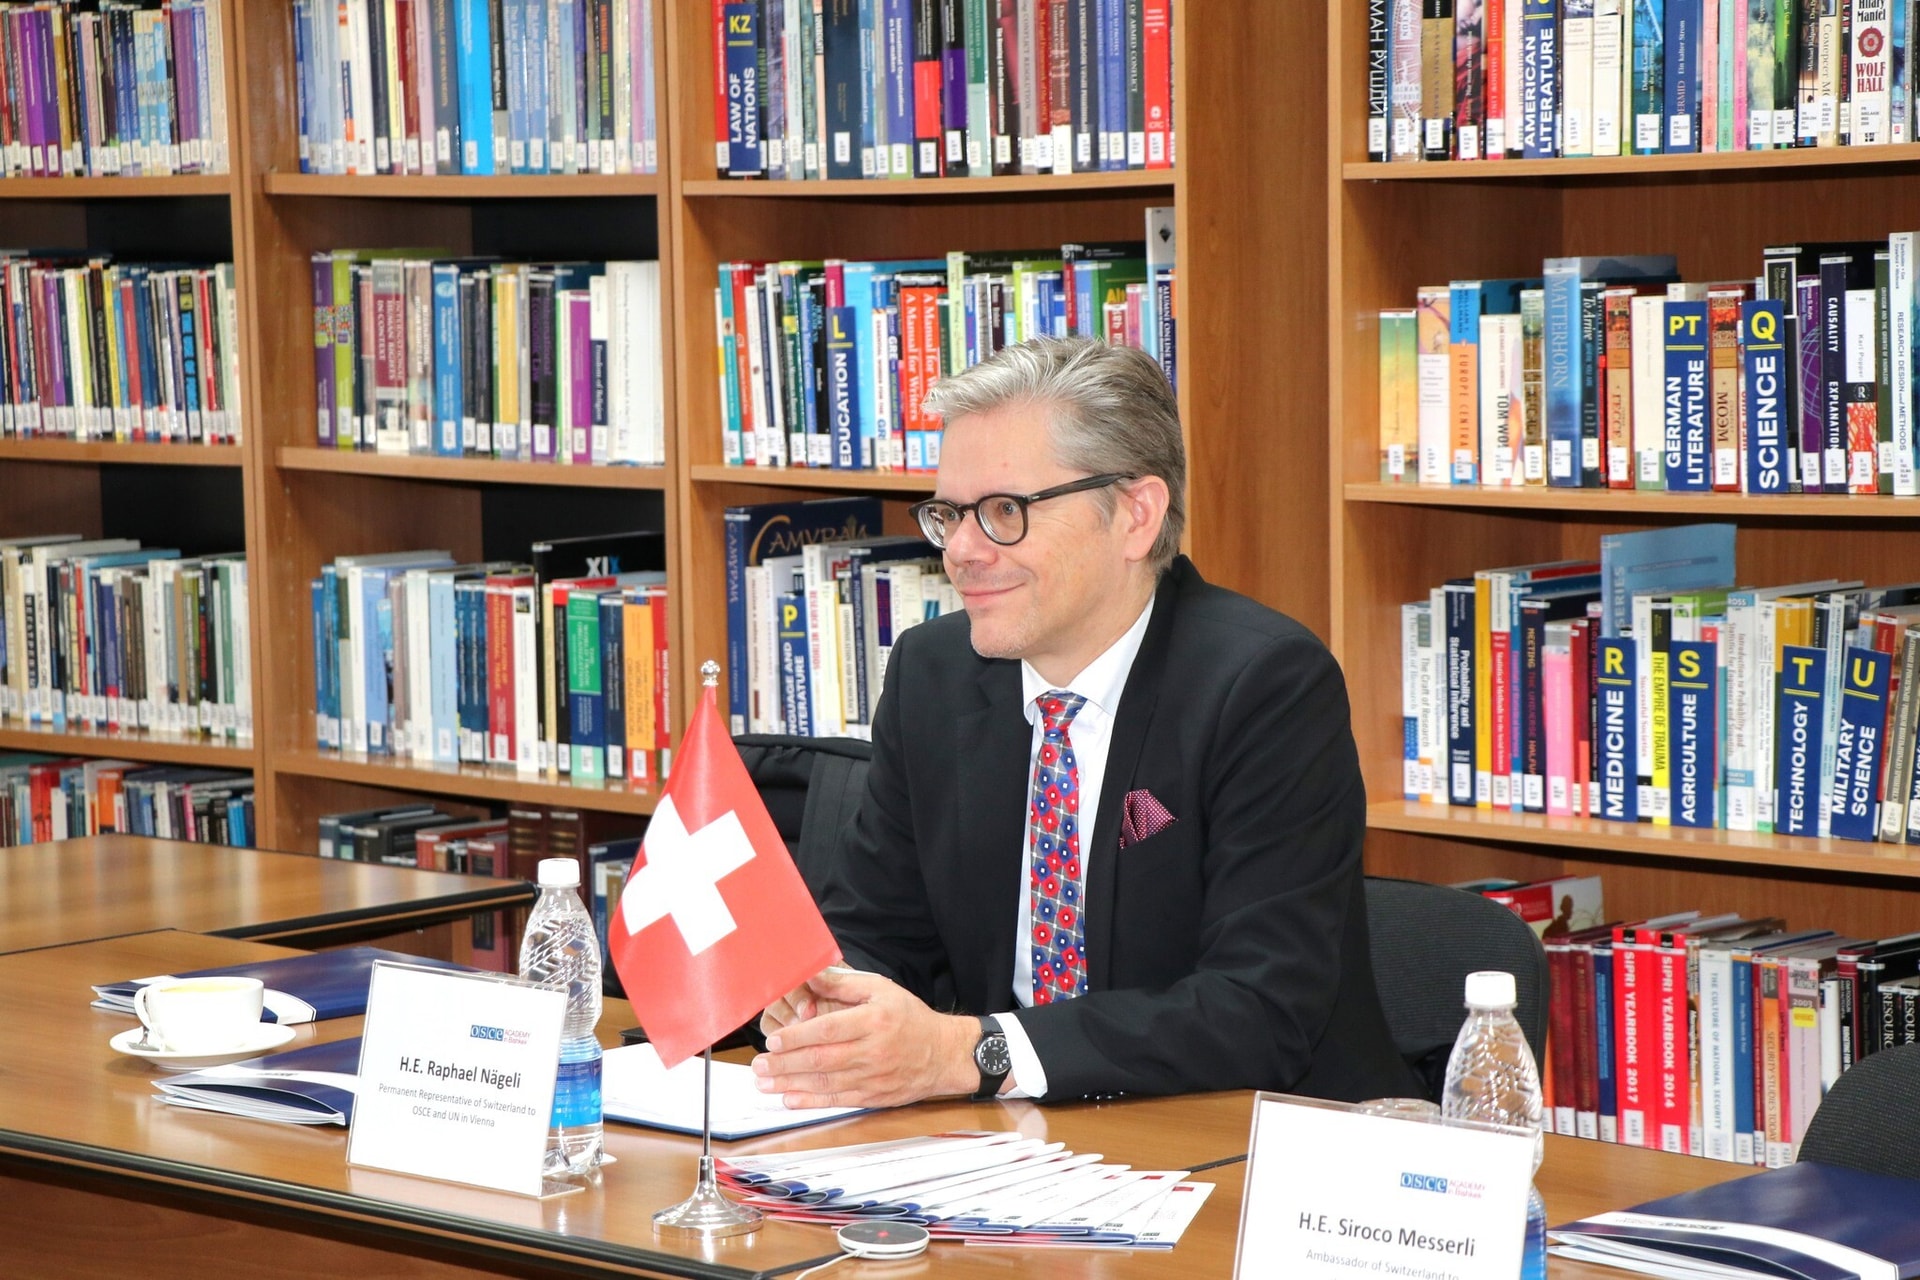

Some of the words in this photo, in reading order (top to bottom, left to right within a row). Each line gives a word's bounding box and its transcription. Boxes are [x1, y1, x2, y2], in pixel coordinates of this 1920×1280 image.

[730, 15, 751, 33] KZ
[1130, 4, 1136, 17] OF
[1857, 9, 1886, 22] Mantel
[512, 43, 519, 52] of
[1822, 24, 1833, 78] Сомерсет
[513, 55, 521, 110] International
[730, 74, 741, 98] OF
[1369, 50, 1386, 114] РУШДИ
[1856, 62, 1886, 78] WOLF
[1857, 76, 1885, 93] HALL
[744, 67, 756, 148] NATIONS
[1524, 35, 1536, 147] AMERICAN
[1539, 28, 1554, 153] LITERATURE
[731, 102, 742, 143] LAW
[377, 300, 384, 311] IN
[906, 294, 915, 303] A
[924, 294, 933, 303] A
[1583, 296, 1596, 308] To
[377, 313, 386, 361] CONTEXT
[833, 315, 845, 338] L
[906, 306, 917, 353] Manual
[924, 306, 935, 353] Manual
[1551, 279, 1569, 388] MATTERHORN
[1584, 310, 1596, 340] Arrive
[1670, 316, 1701, 336] PT
[1751, 311, 1776, 341] Q
[1828, 297, 1838, 352] CAUSALITY
[1897, 312, 1905, 358] RESEARCH
[888, 336, 898, 360] GRE
[908, 356, 918, 373] for
[926, 356, 936, 373] for
[1857, 352, 1865, 379] Popper
[596, 378, 603, 388] of
[1459, 354, 1469, 397] EUROPE
[1898, 360, 1906, 392] DESIGN
[595, 390, 603, 421] Religion
[835, 353, 852, 467] EDUCATION
[909, 377, 919, 421] Writers
[1497, 394, 1509, 420] TOM
[1612, 393, 1622, 438] ГЕССЕ
[1717, 392, 1728, 442] МОЭМ
[1829, 381, 1840, 450] EXPLANATION
[1898, 393, 1906, 405] and
[1459, 404, 1470, 449] CENTRA
[1666, 376, 1681, 468] GERMAN
[1688, 360, 1703, 484] LITERATURE
[1756, 357, 1779, 489] SCIENCE
[1898, 406, 1907, 451] METHODS
[783, 605, 798, 628] P
[783, 642, 793, 671] AND
[1421, 658, 1430, 672] The
[1449, 637, 1460, 688] Statistical
[1604, 647, 1624, 674] R
[1653, 656, 1665, 673] THE
[1678, 650, 1701, 678] S
[1736, 633, 1745, 678] Introduction
[1791, 657, 1814, 685] T
[1853, 658, 1875, 688] U
[1422, 674, 1430, 696] Craft
[1459, 650, 1470, 704] Probability
[1640, 675, 1648, 716] Successful
[1653, 674, 1665, 713] EMPIRE
[1737, 680, 1746, 688] to
[786, 673, 798, 737] NGUAGE
[1422, 697, 1430, 706] of
[1451, 690, 1460, 739] Inference
[1462, 707, 1470, 727] and
[1735, 690, 1746, 730] Probability
[1422, 708, 1431, 747] Research
[1640, 718, 1648, 757] Societies
[1654, 715, 1666, 728] OF
[1737, 732, 1746, 747] and
[1606, 690, 1624, 817] MEDICINE
[1654, 730, 1666, 771] TRAUMA
[1682, 694, 1697, 823] AGRICULTURE
[1789, 701, 1808, 832] TECHNOLOGY
[1832, 718, 1854, 814] MILITARY
[1853, 725, 1875, 817] SCIENCE
[1624, 951, 1635, 987] SIPRI
[1661, 956, 1672, 992] SIPRI
[1711, 973, 1719, 988] THE
[1625, 992, 1637, 1064] YEARBOOK
[1711, 991, 1719, 1029] CULTURE
[1882, 992, 1894, 1049] RESOURC
[1904, 993, 1915, 1045] RESOURC
[1662, 996, 1674, 1068] YEARBOOK
[1712, 1031, 1720, 1042] OF
[1712, 1045, 1720, 1086] NATIONAL
[1767, 1031, 1775, 1073] SECURITY
[400, 1056, 423, 1075] H.E.
[427, 1060, 477, 1083] Raphael
[480, 1065, 522, 1090] Nägeli
[1626, 1068, 1638, 1103] 2017
[1663, 1073, 1675, 1108] 2014
[378, 1083, 417, 1099] Permanent
[418, 1088, 473, 1106] Representative
[474, 1096, 482, 1107] of
[483, 1098, 527, 1115] Switzerland
[528, 1105, 536, 1116] to
[1713, 1090, 1722, 1130] SECURITY
[1767, 1074, 1776, 1111] STUDIES
[412, 1105, 430, 1118] OSCE
[433, 1108, 447, 1120] and
[448, 1111, 460, 1122] UN
[460, 1113, 468, 1123] in
[470, 1114, 495, 1128] Vienna
[1767, 1113, 1776, 1141] TODAY
[1299, 1211, 1332, 1234] H.E.
[1338, 1218, 1392, 1243] Siroco
[1398, 1227, 1476, 1257] Messerli
[1306, 1249, 1369, 1270] Ambassador
[1371, 1260, 1382, 1272] of
[1385, 1261, 1446, 1280] Switzerland
